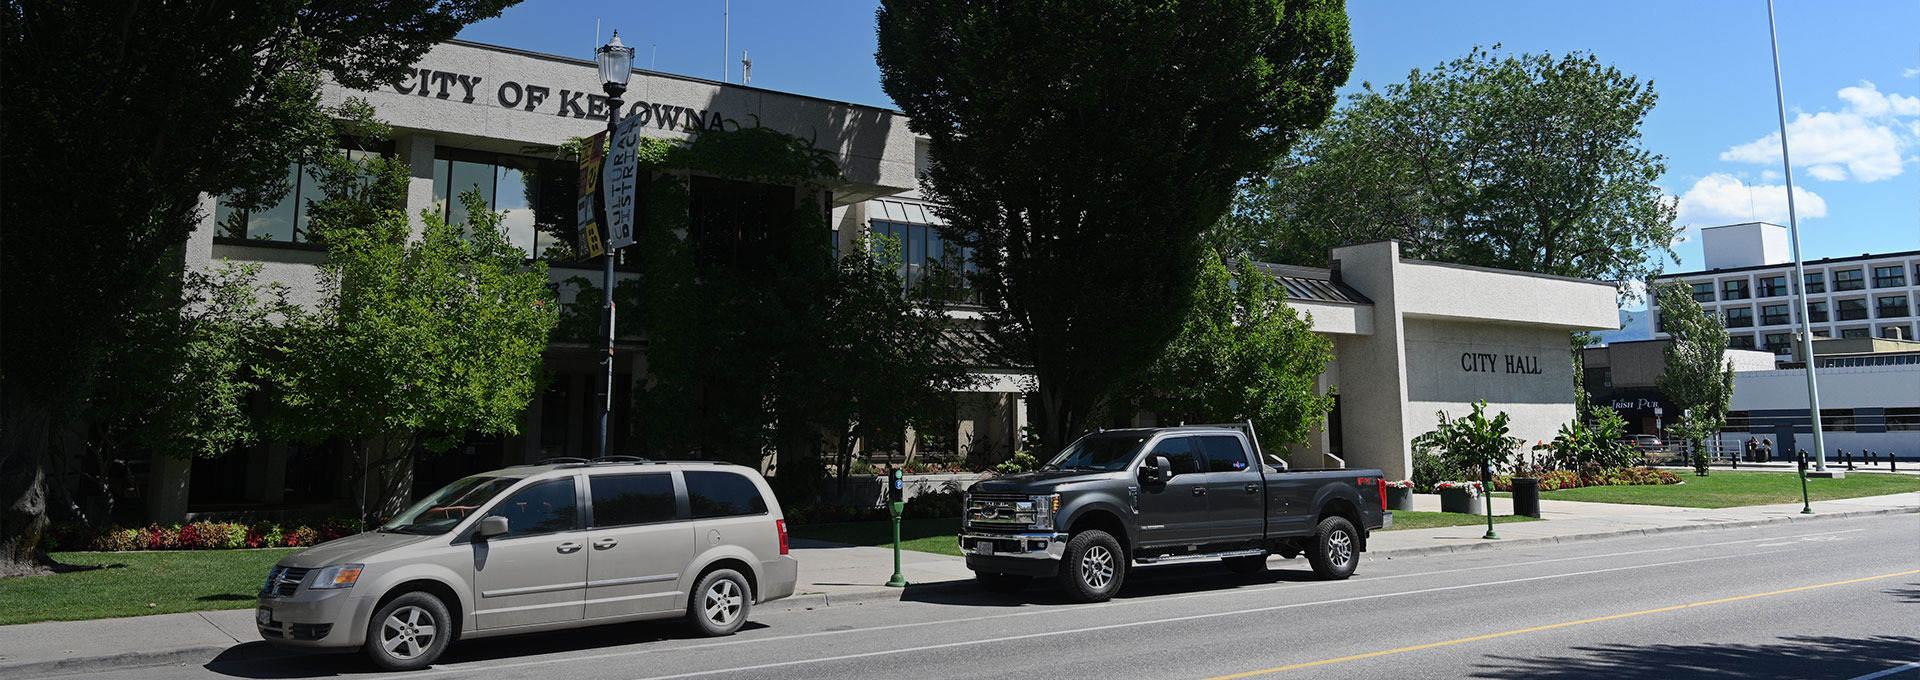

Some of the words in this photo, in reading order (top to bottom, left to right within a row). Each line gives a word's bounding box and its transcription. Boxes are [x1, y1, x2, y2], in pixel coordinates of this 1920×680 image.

[392, 66, 482, 104] CITY
[497, 81, 550, 112] OF
[557, 89, 725, 134] KEOWNA
[611, 130, 627, 240] CULTURAL
[621, 120, 638, 238] DISTRICT
[1461, 352, 1498, 373] CITY
[1504, 354, 1543, 375] HALL
